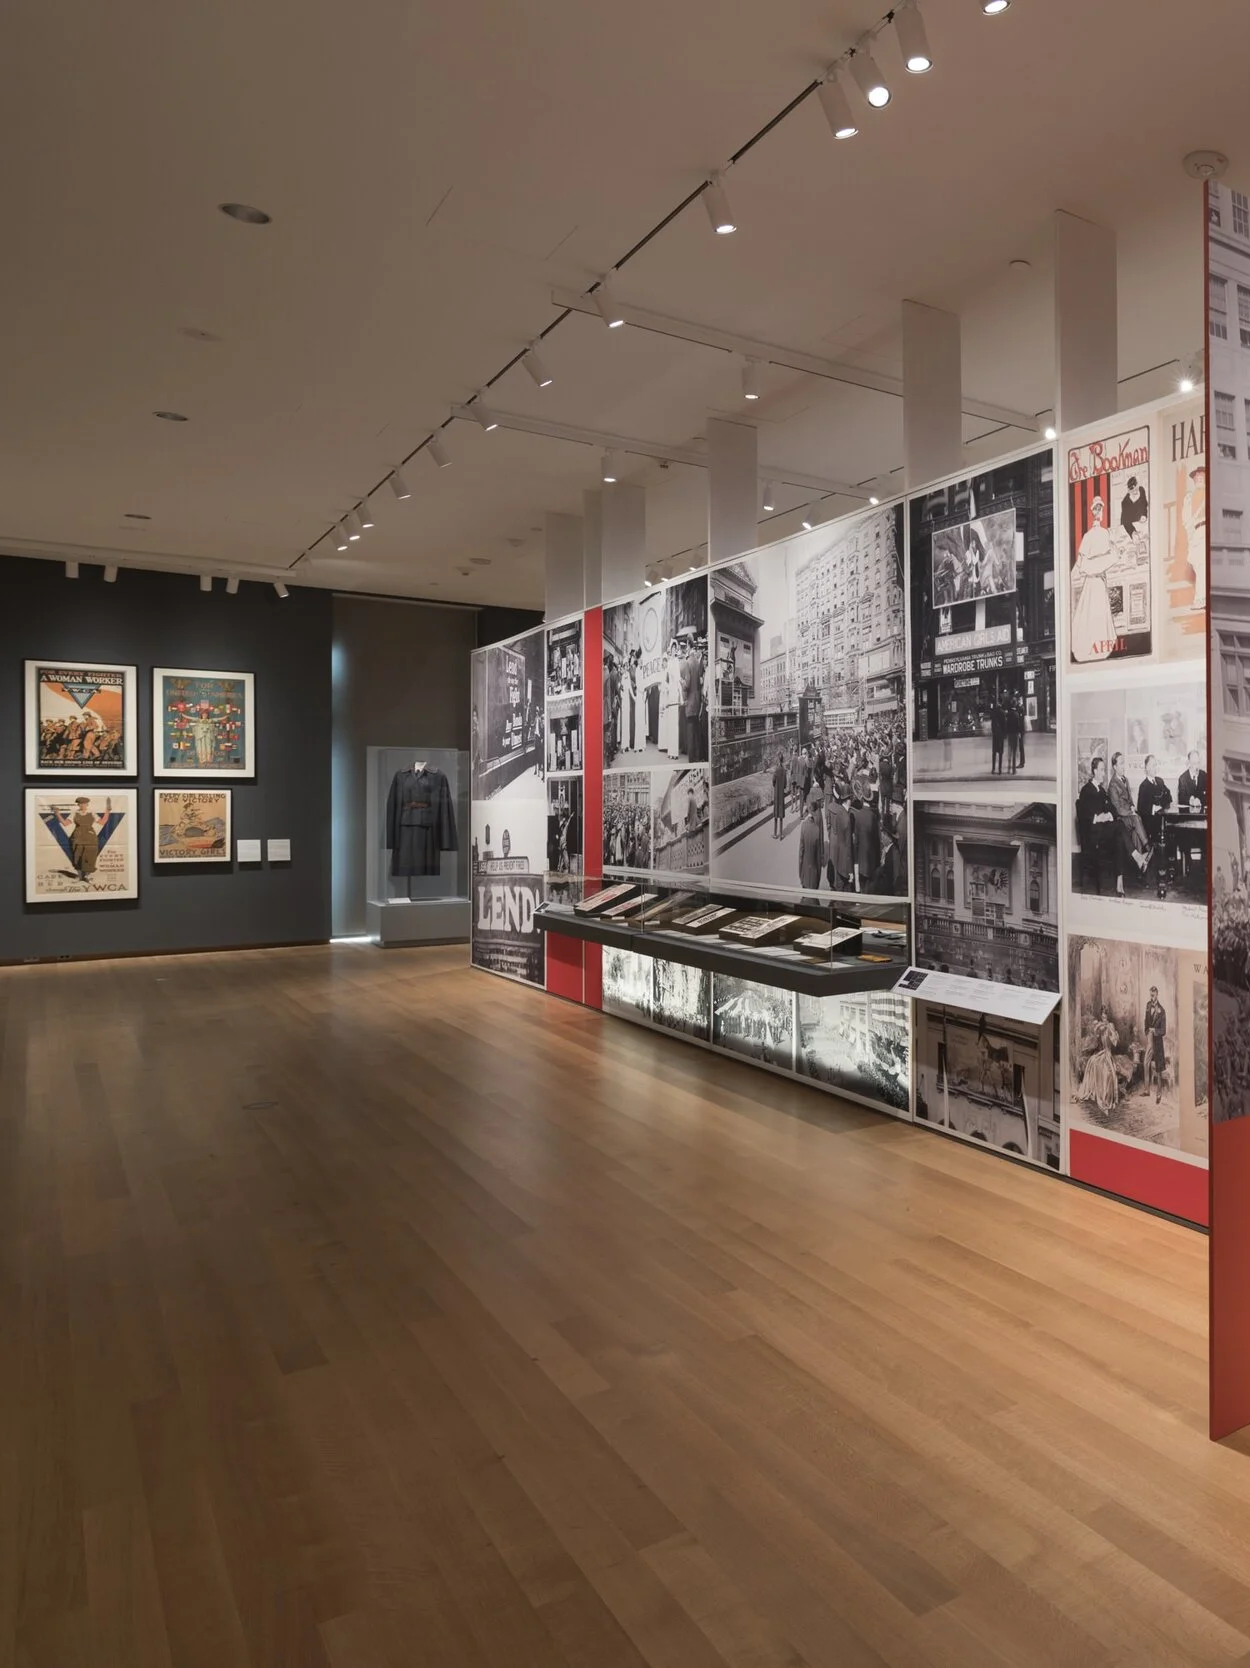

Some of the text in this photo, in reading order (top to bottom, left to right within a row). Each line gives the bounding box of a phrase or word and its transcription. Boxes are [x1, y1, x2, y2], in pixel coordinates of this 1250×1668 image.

[936, 634, 971, 650] AMERICAN
[1090, 639, 1127, 655] APRIL
[506, 655, 517, 675] Lend
[643, 657, 660, 680] PEACE
[943, 660, 975, 674] WARDROBE
[977, 656, 1003, 669] TRUNKS
[85, 676, 123, 684] WORKER
[82, 883, 128, 892] YWCA
[478, 886, 541, 934] LEND!
